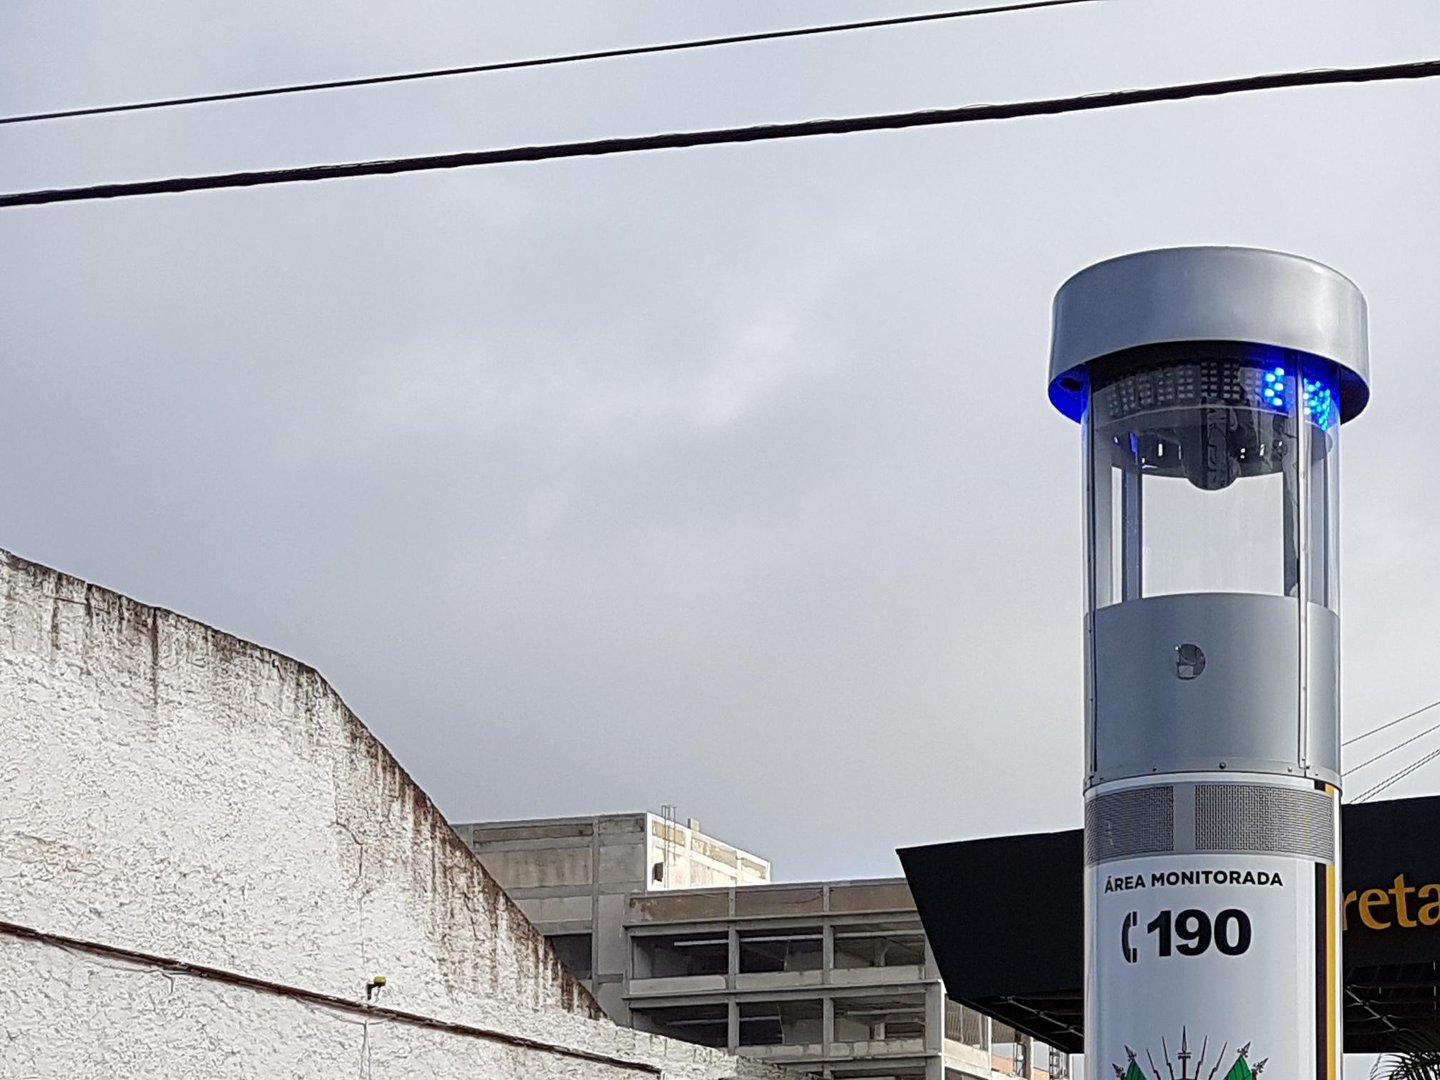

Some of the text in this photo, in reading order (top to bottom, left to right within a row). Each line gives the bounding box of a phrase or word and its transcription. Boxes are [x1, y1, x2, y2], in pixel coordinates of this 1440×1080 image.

[1104, 870, 1283, 894] ÁREA MONITORADA
[1147, 908, 1252, 957] 190
